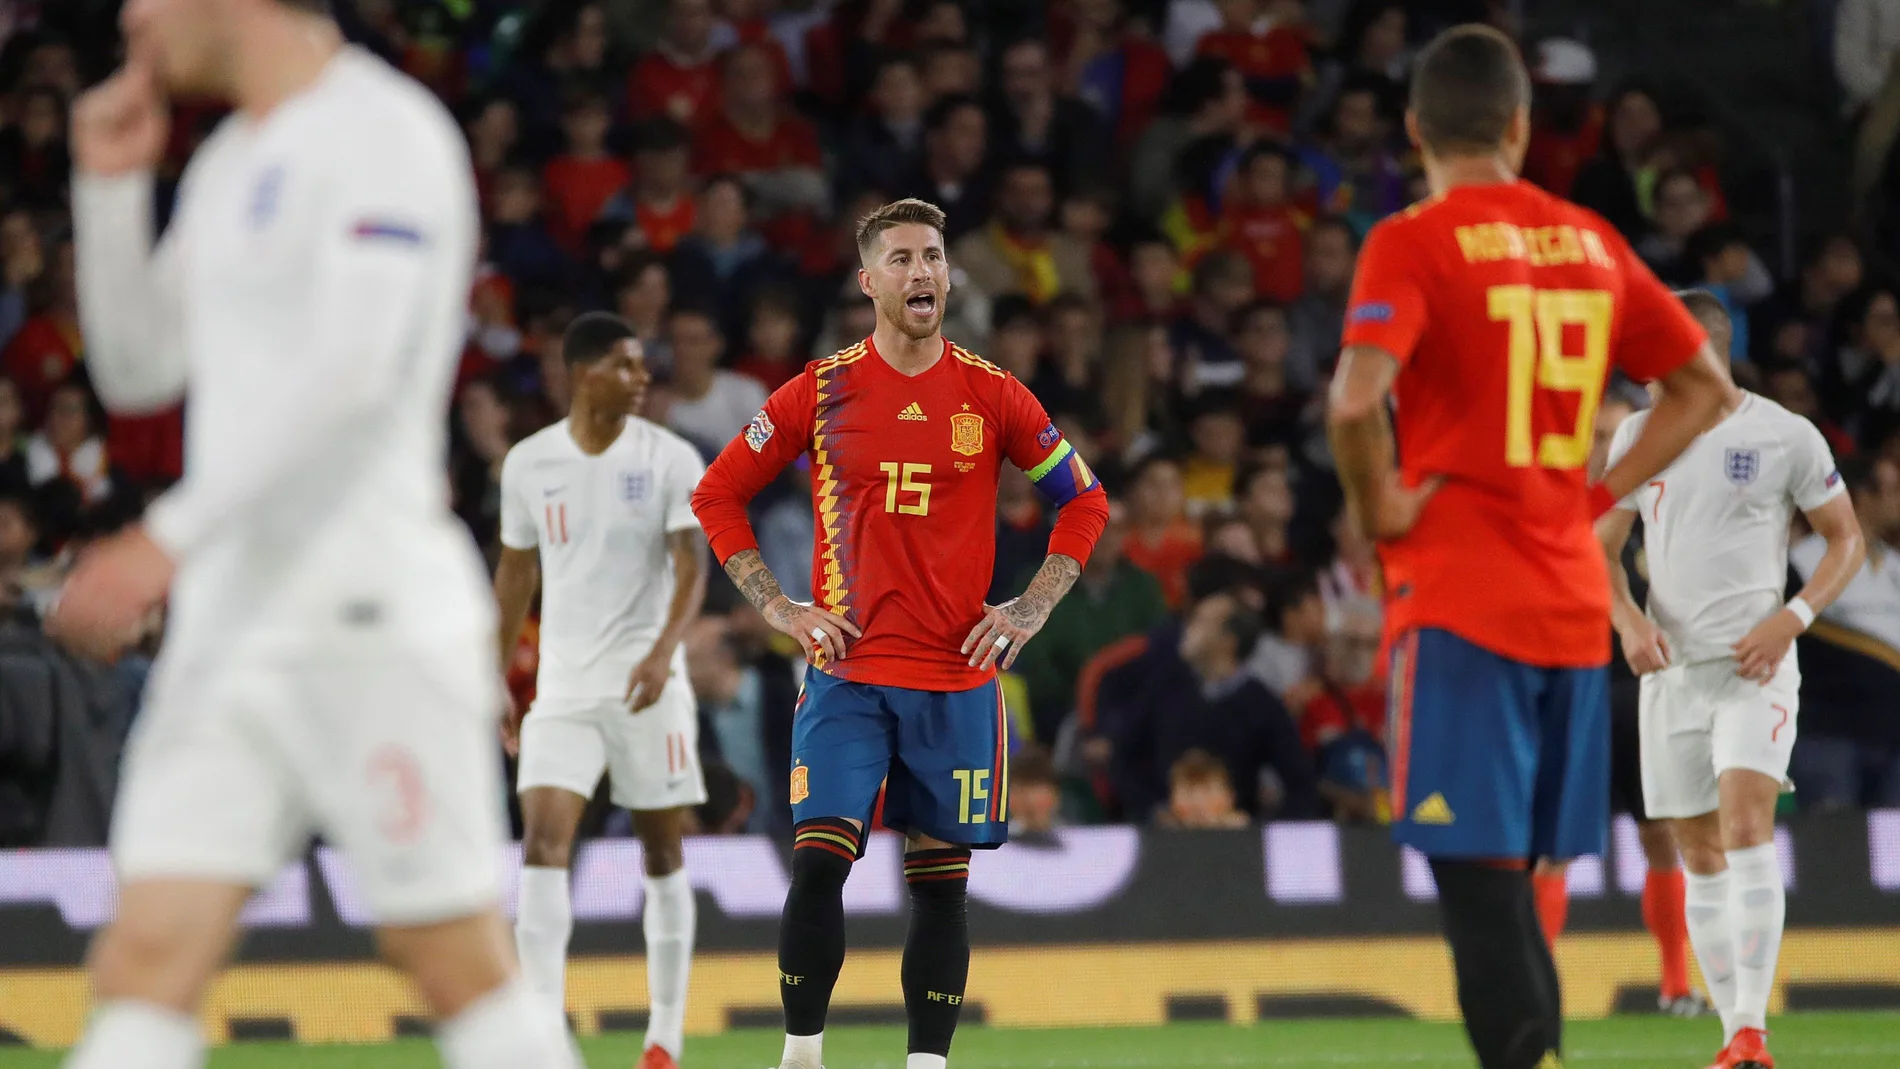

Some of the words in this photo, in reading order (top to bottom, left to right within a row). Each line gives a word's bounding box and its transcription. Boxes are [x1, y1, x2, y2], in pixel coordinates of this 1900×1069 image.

[1487, 284, 1613, 470] 19
[898, 413, 928, 421] adidas
[879, 461, 932, 516] 15
[1648, 480, 1666, 524] 7
[545, 502, 568, 544] 11
[1770, 702, 1788, 744] 7
[666, 731, 687, 774] 11
[363, 742, 435, 846] 3
[952, 768, 989, 824] 15
[778, 970, 805, 986] FEF
